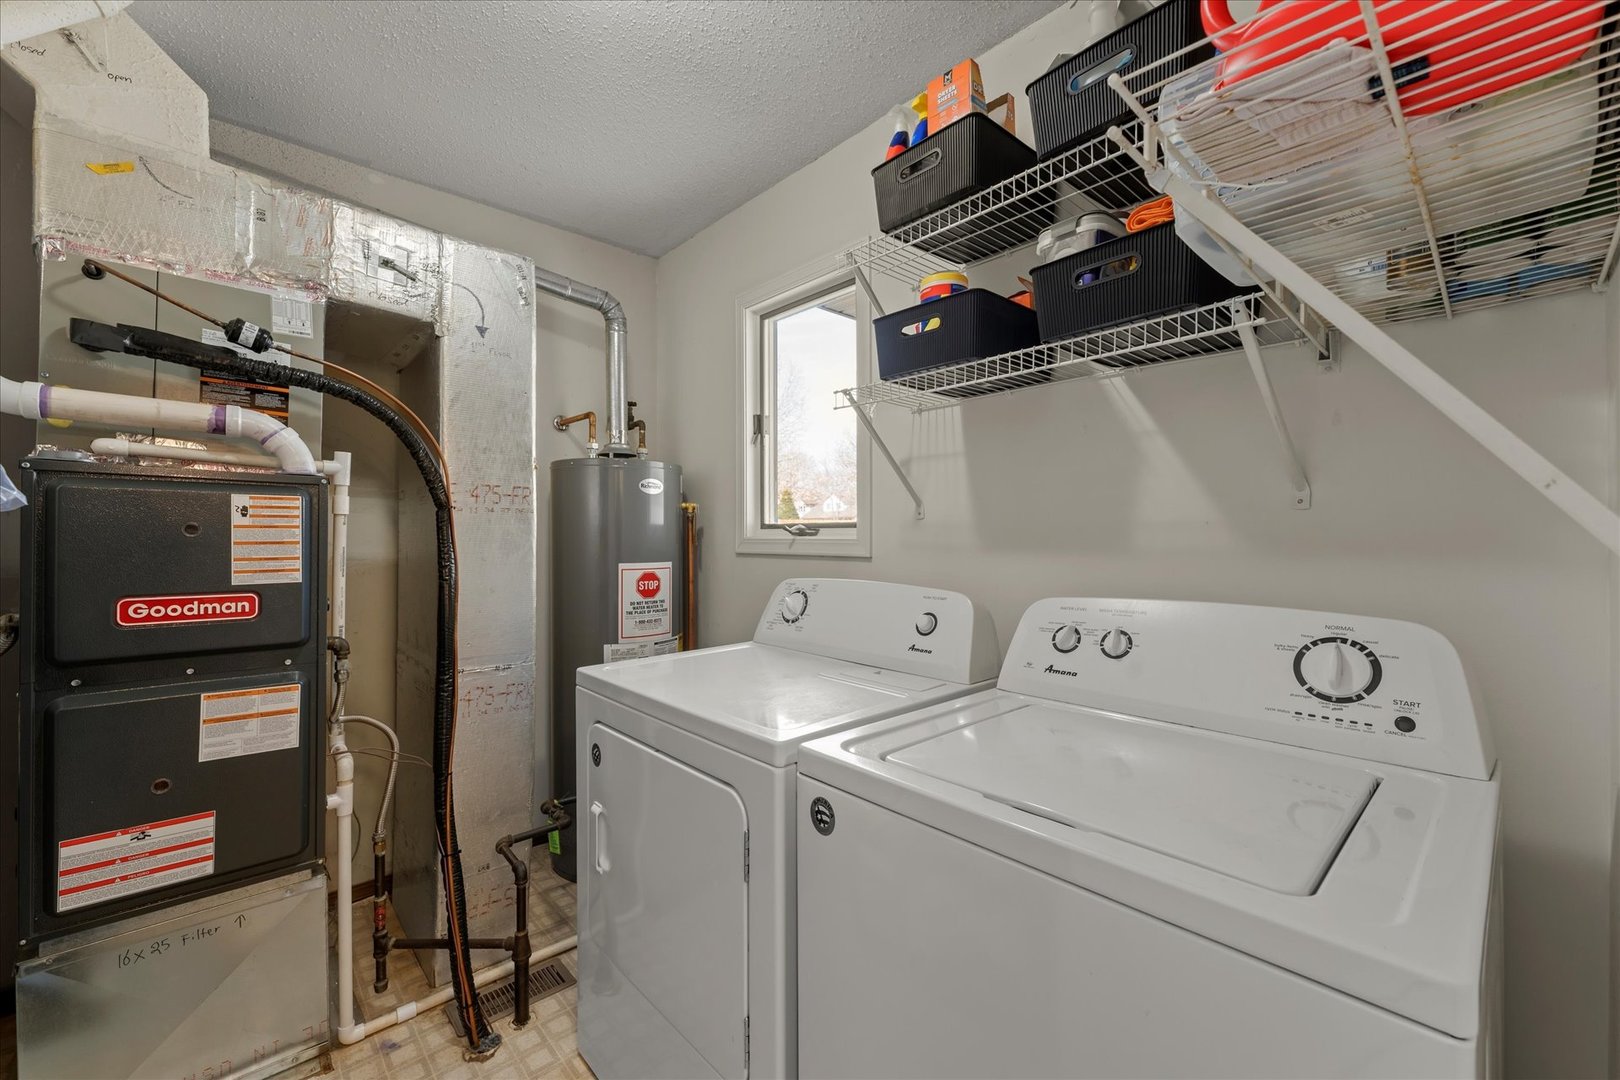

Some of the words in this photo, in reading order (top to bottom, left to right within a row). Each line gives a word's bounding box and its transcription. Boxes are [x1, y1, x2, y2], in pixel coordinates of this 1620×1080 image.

[107, 72, 132, 84] open
[937, 85, 956, 98] DRYER
[937, 90, 957, 104] SHEETS
[638, 580, 659, 591] STOP
[128, 600, 250, 619] Goodman
[1324, 624, 1356, 632] NORMAL
[907, 643, 933, 655] Amana
[1043, 664, 1078, 677] Amana
[1392, 699, 1421, 708] START
[1384, 729, 1408, 738] CANCEL
[128, 825, 151, 834] DANGER
[128, 853, 151, 862] DANGER
[181, 926, 220, 946] Filter
